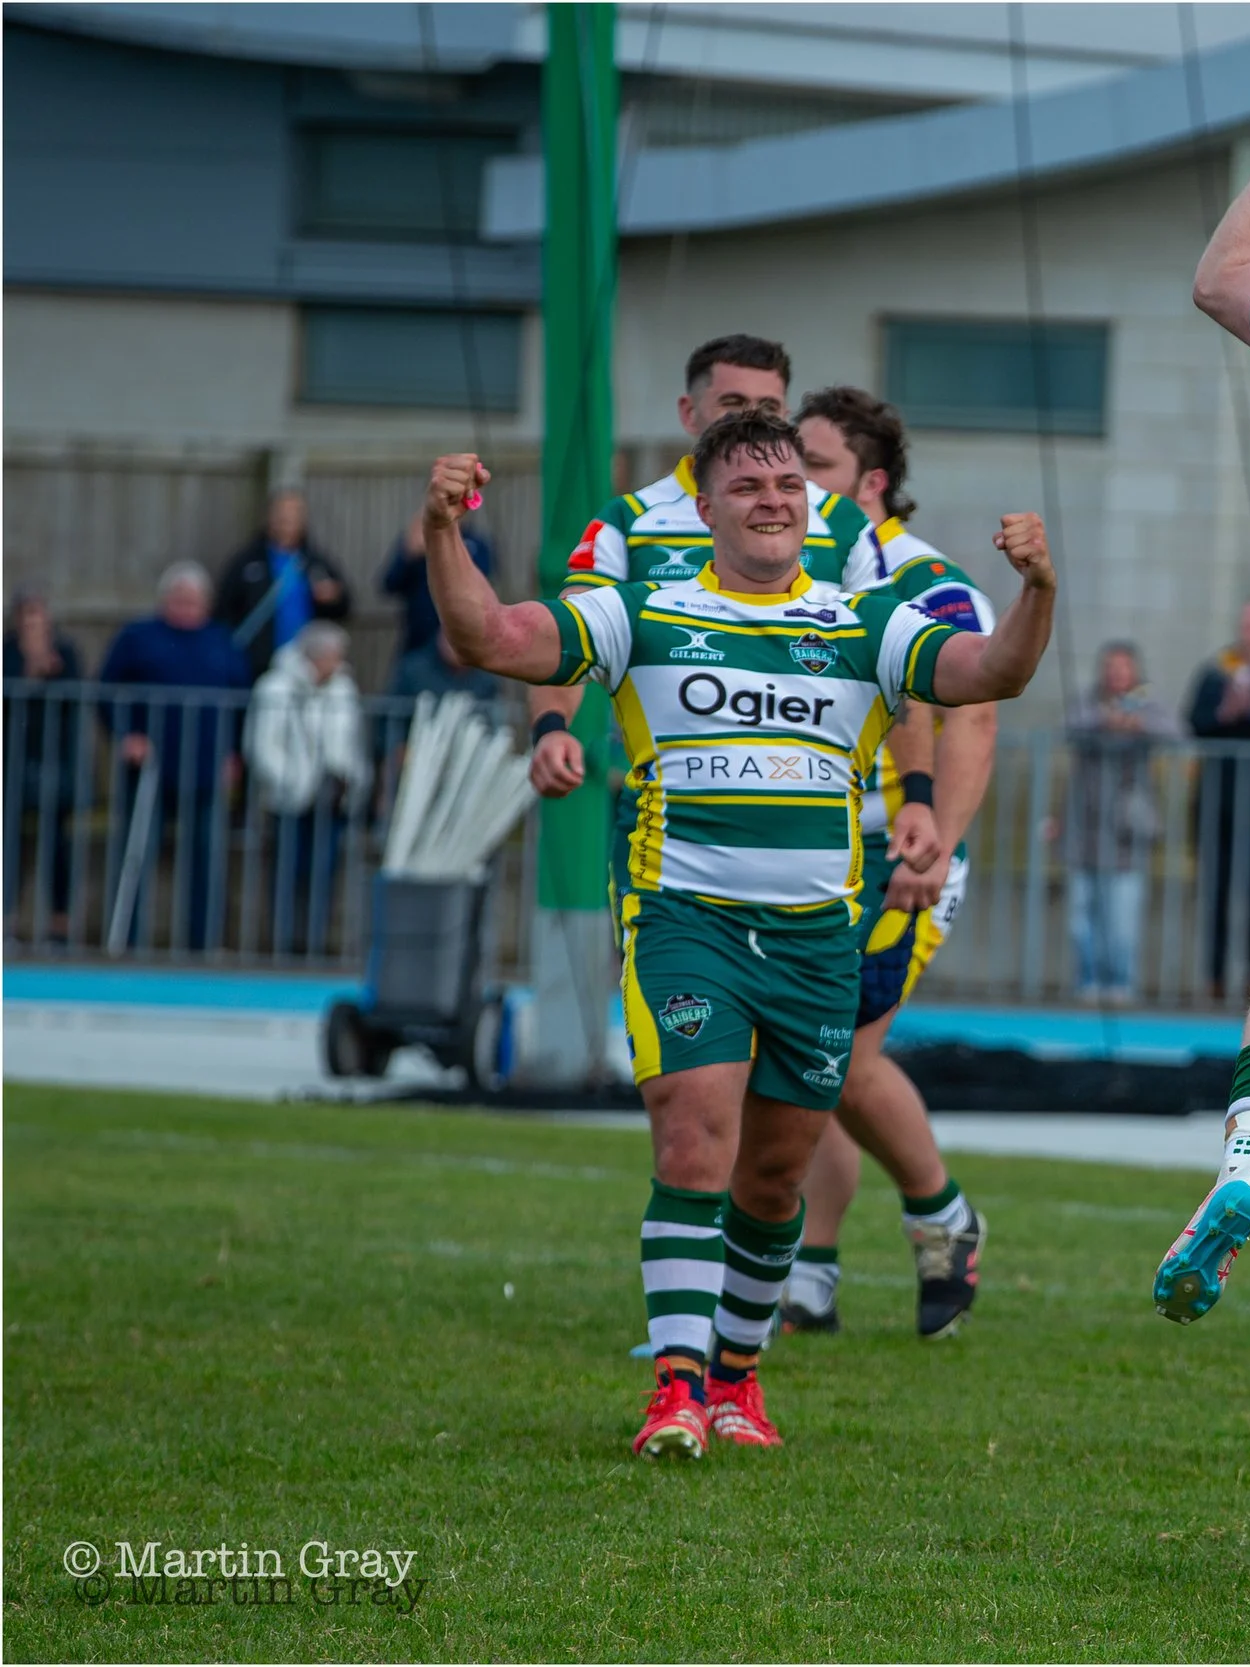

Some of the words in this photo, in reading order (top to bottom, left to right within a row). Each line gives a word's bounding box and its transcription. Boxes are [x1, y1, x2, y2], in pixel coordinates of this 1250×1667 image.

[669, 650, 726, 661] GILBERT
[678, 672, 834, 727] Ogier
[686, 756, 833, 781] PRAXIS
